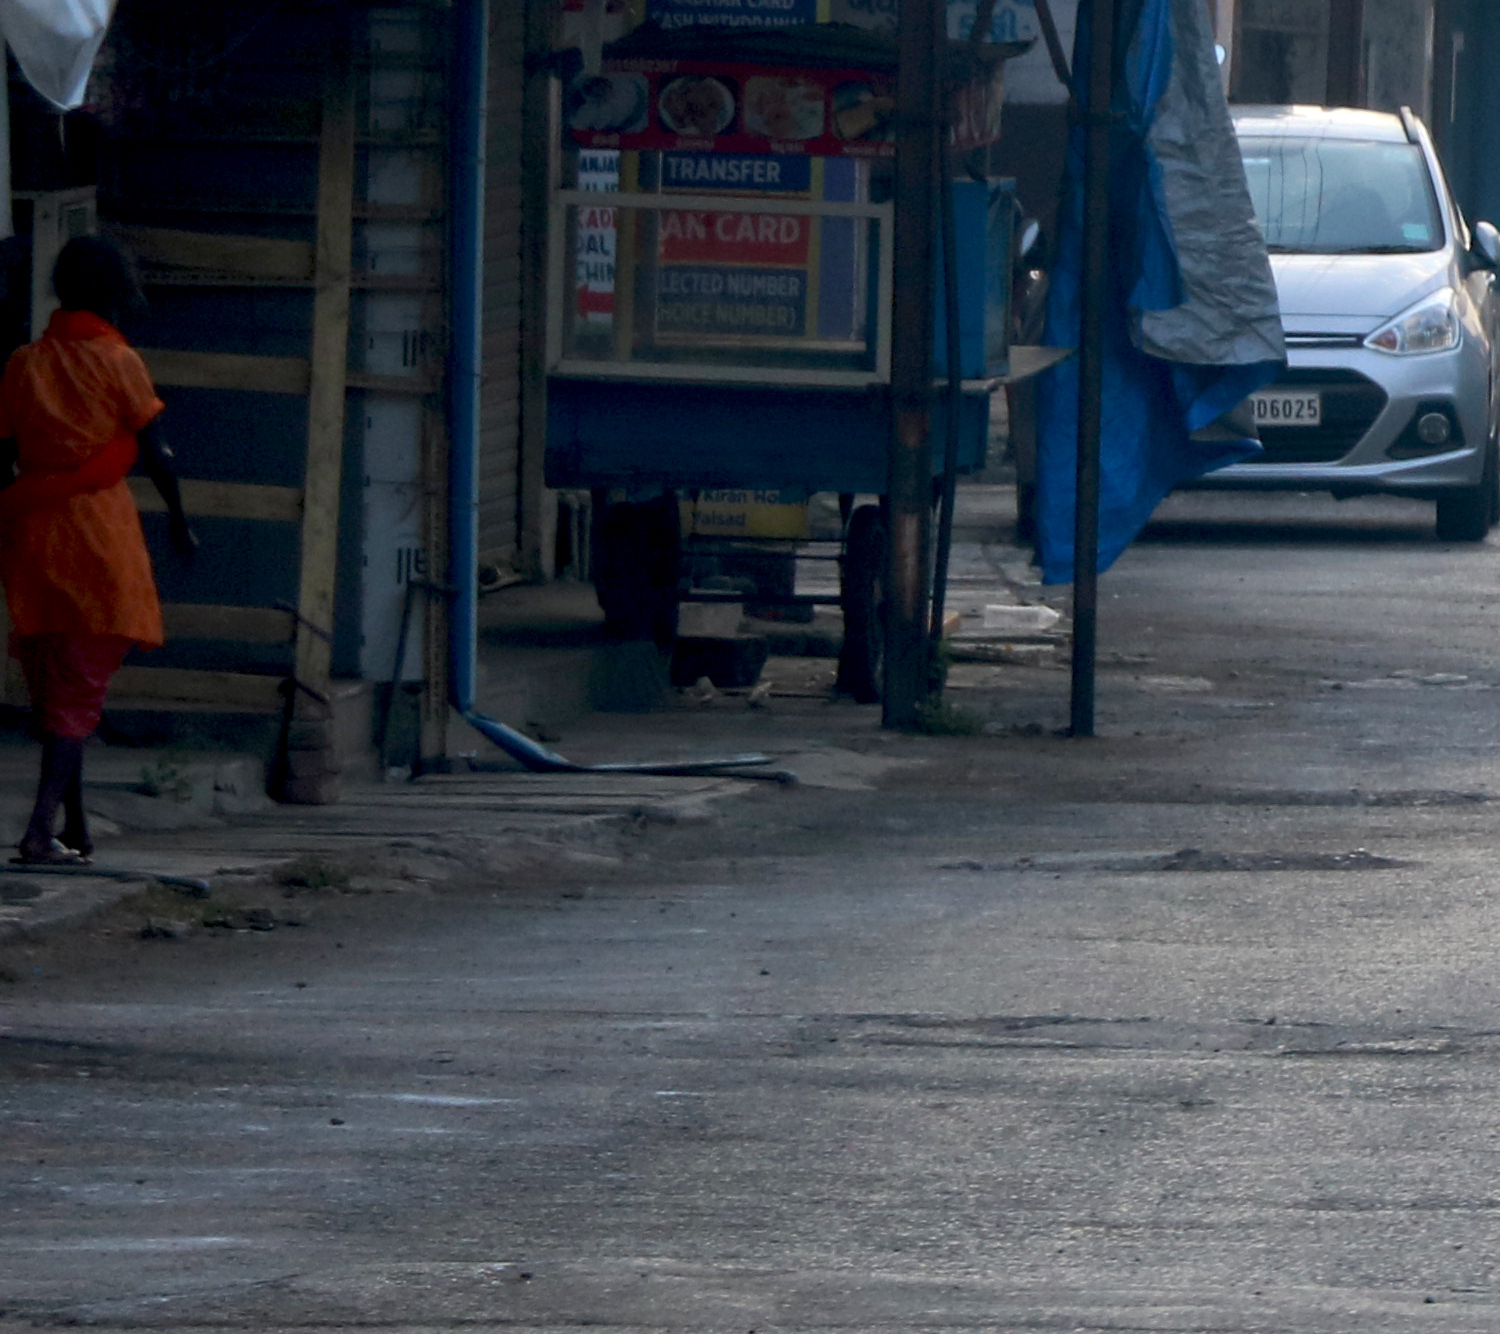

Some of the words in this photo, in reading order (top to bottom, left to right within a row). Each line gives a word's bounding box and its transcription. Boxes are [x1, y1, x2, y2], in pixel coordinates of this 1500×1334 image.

[667, 156, 782, 184] TRANSFER
[659, 214, 707, 244] AN
[715, 214, 801, 246] CARD
[660, 270, 722, 294] LECTED
[727, 272, 800, 297] NUMBER
[716, 303, 797, 330] NUMBER)
